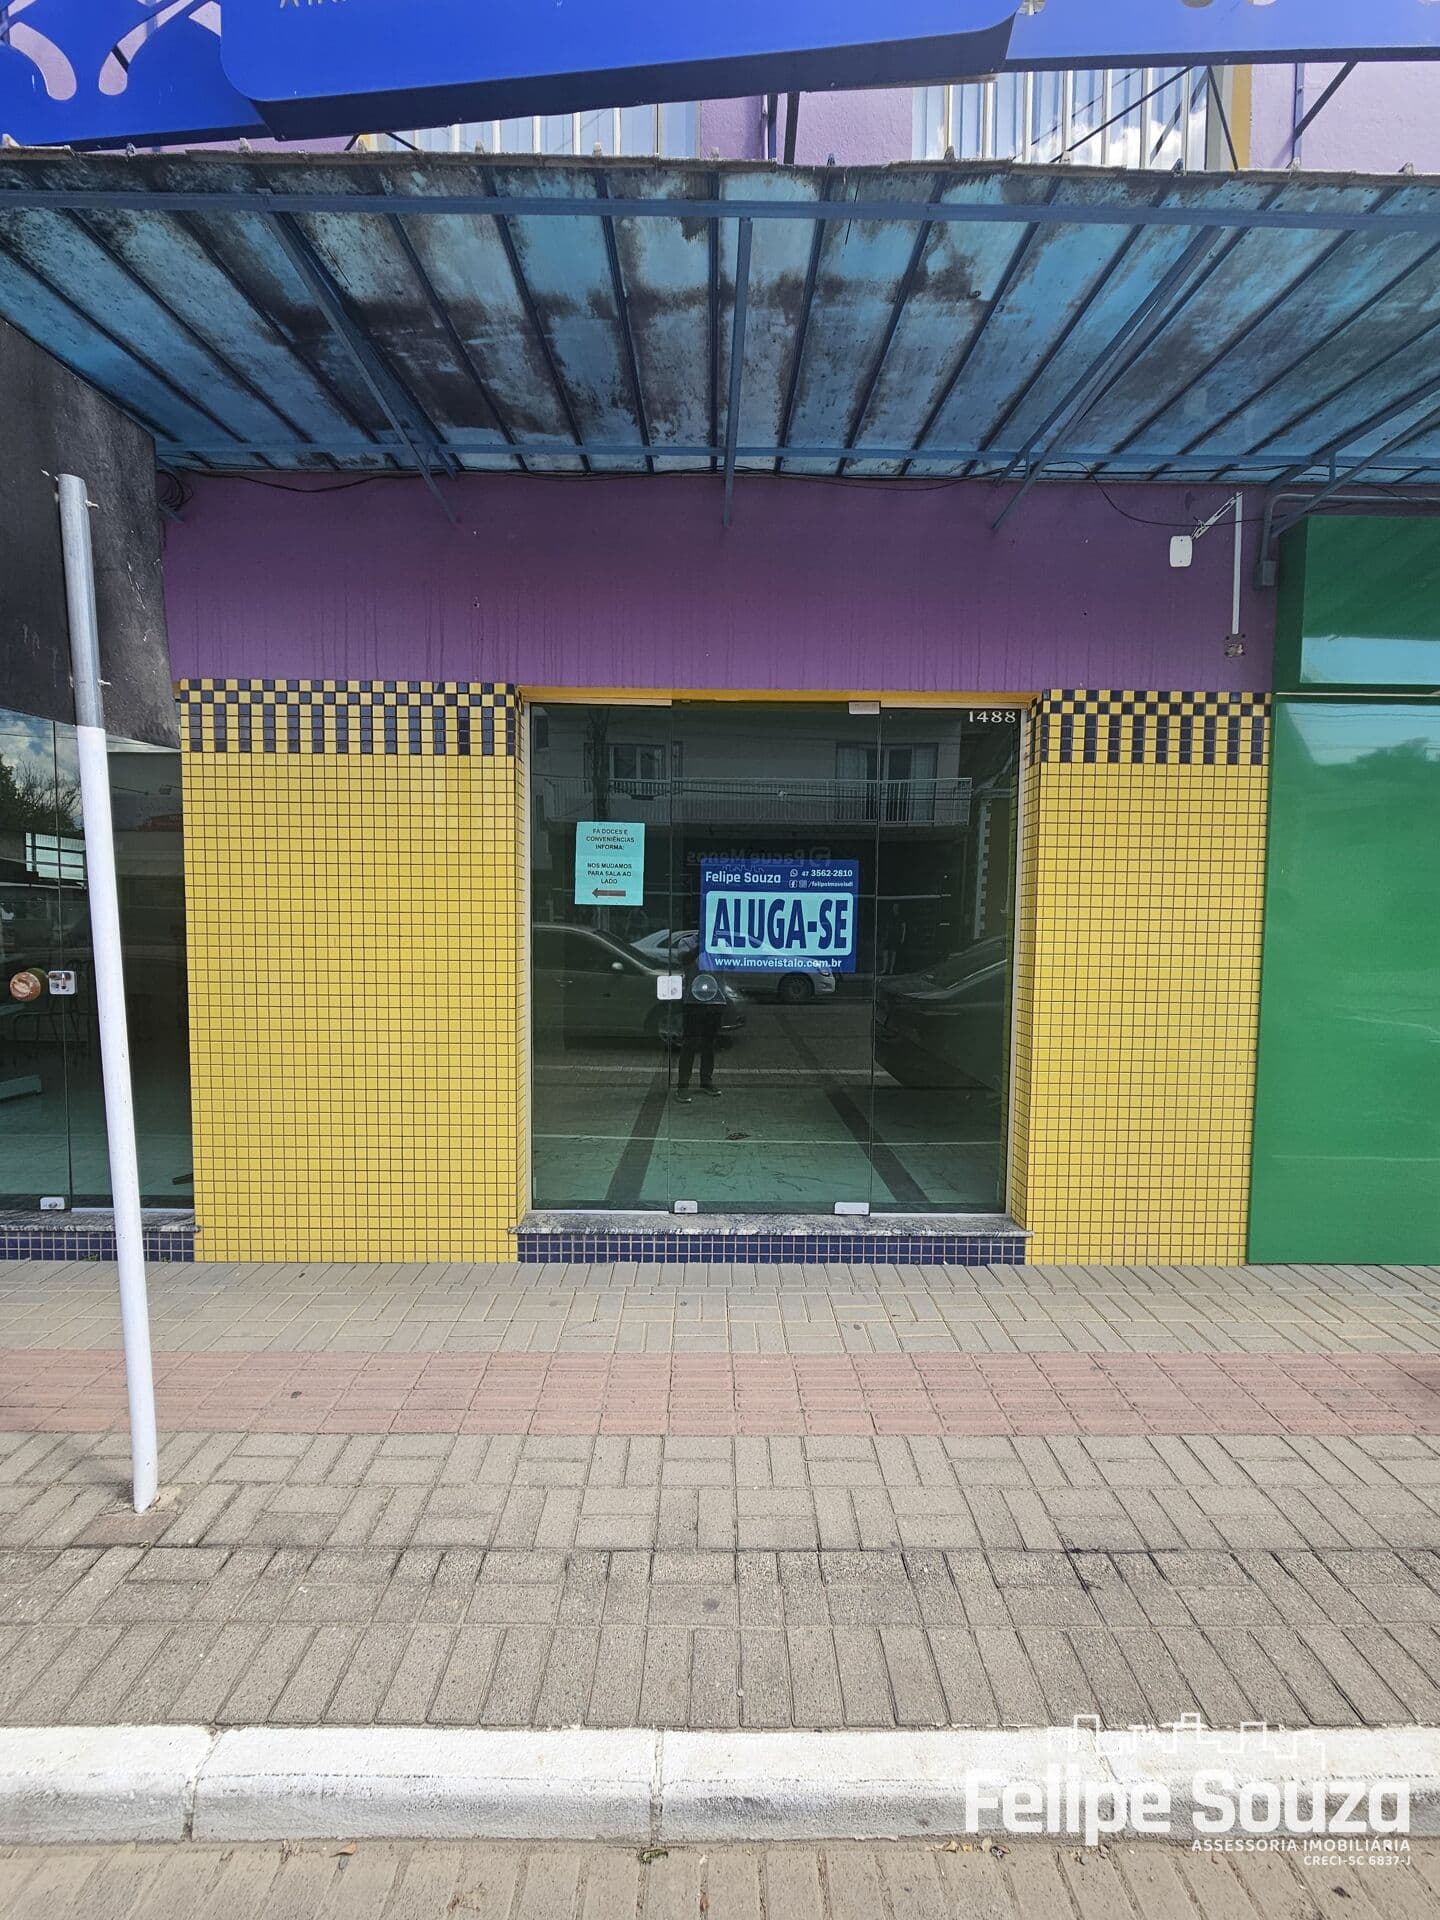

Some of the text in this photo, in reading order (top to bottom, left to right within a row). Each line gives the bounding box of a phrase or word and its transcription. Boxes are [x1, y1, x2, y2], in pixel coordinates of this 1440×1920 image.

[969, 711, 1016, 723] 1488
[705, 871, 781, 884] Felipe Souza
[811, 869, 853, 877] 3562-2810
[711, 898, 848, 949] ALUGA-SE
[714, 957, 842, 968] www.imoveistaio.com.br
